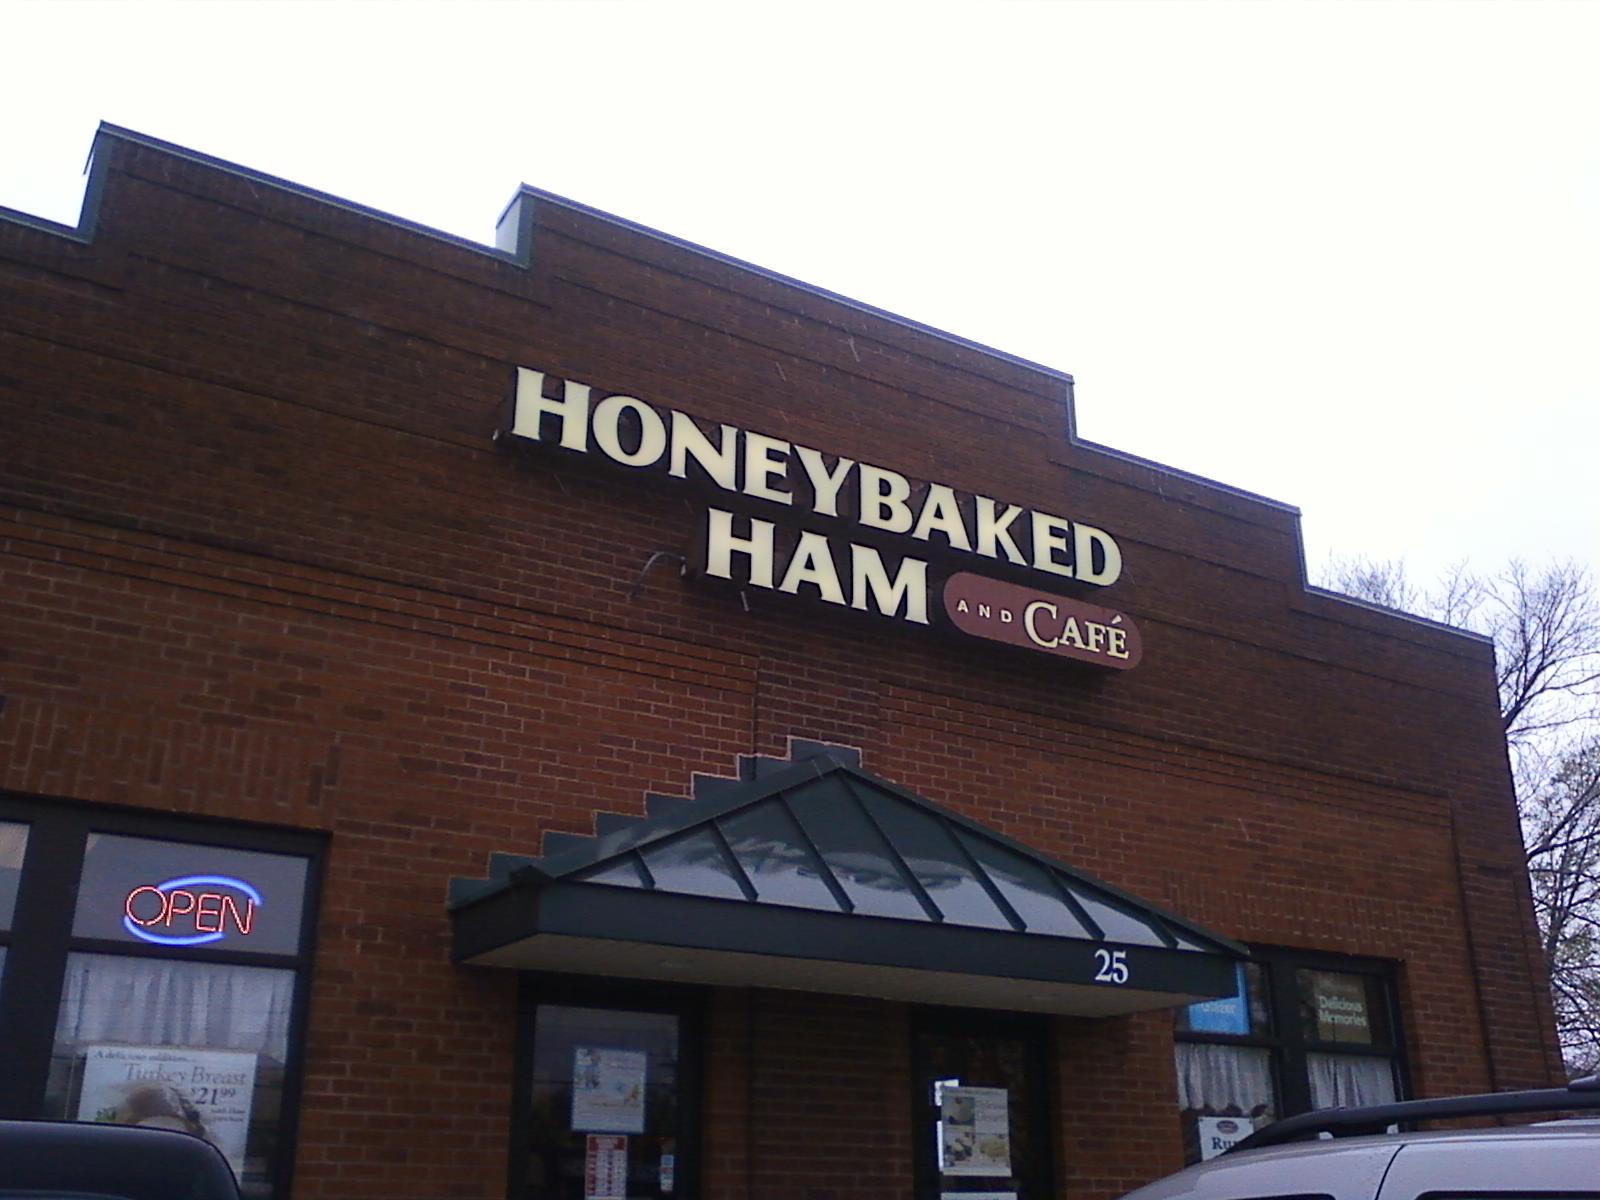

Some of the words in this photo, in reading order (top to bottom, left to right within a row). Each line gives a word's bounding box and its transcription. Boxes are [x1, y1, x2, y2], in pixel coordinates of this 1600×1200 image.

[512, 366, 1123, 587] HONEYBAKED
[705, 508, 930, 625] HAM
[957, 600, 1013, 623] AND
[1024, 601, 1129, 659] CAFÉ
[126, 886, 254, 935] OPEN
[1094, 949, 1129, 984] 25
[124, 1063, 186, 1082] Turkey
[191, 1066, 248, 1085] Breast
